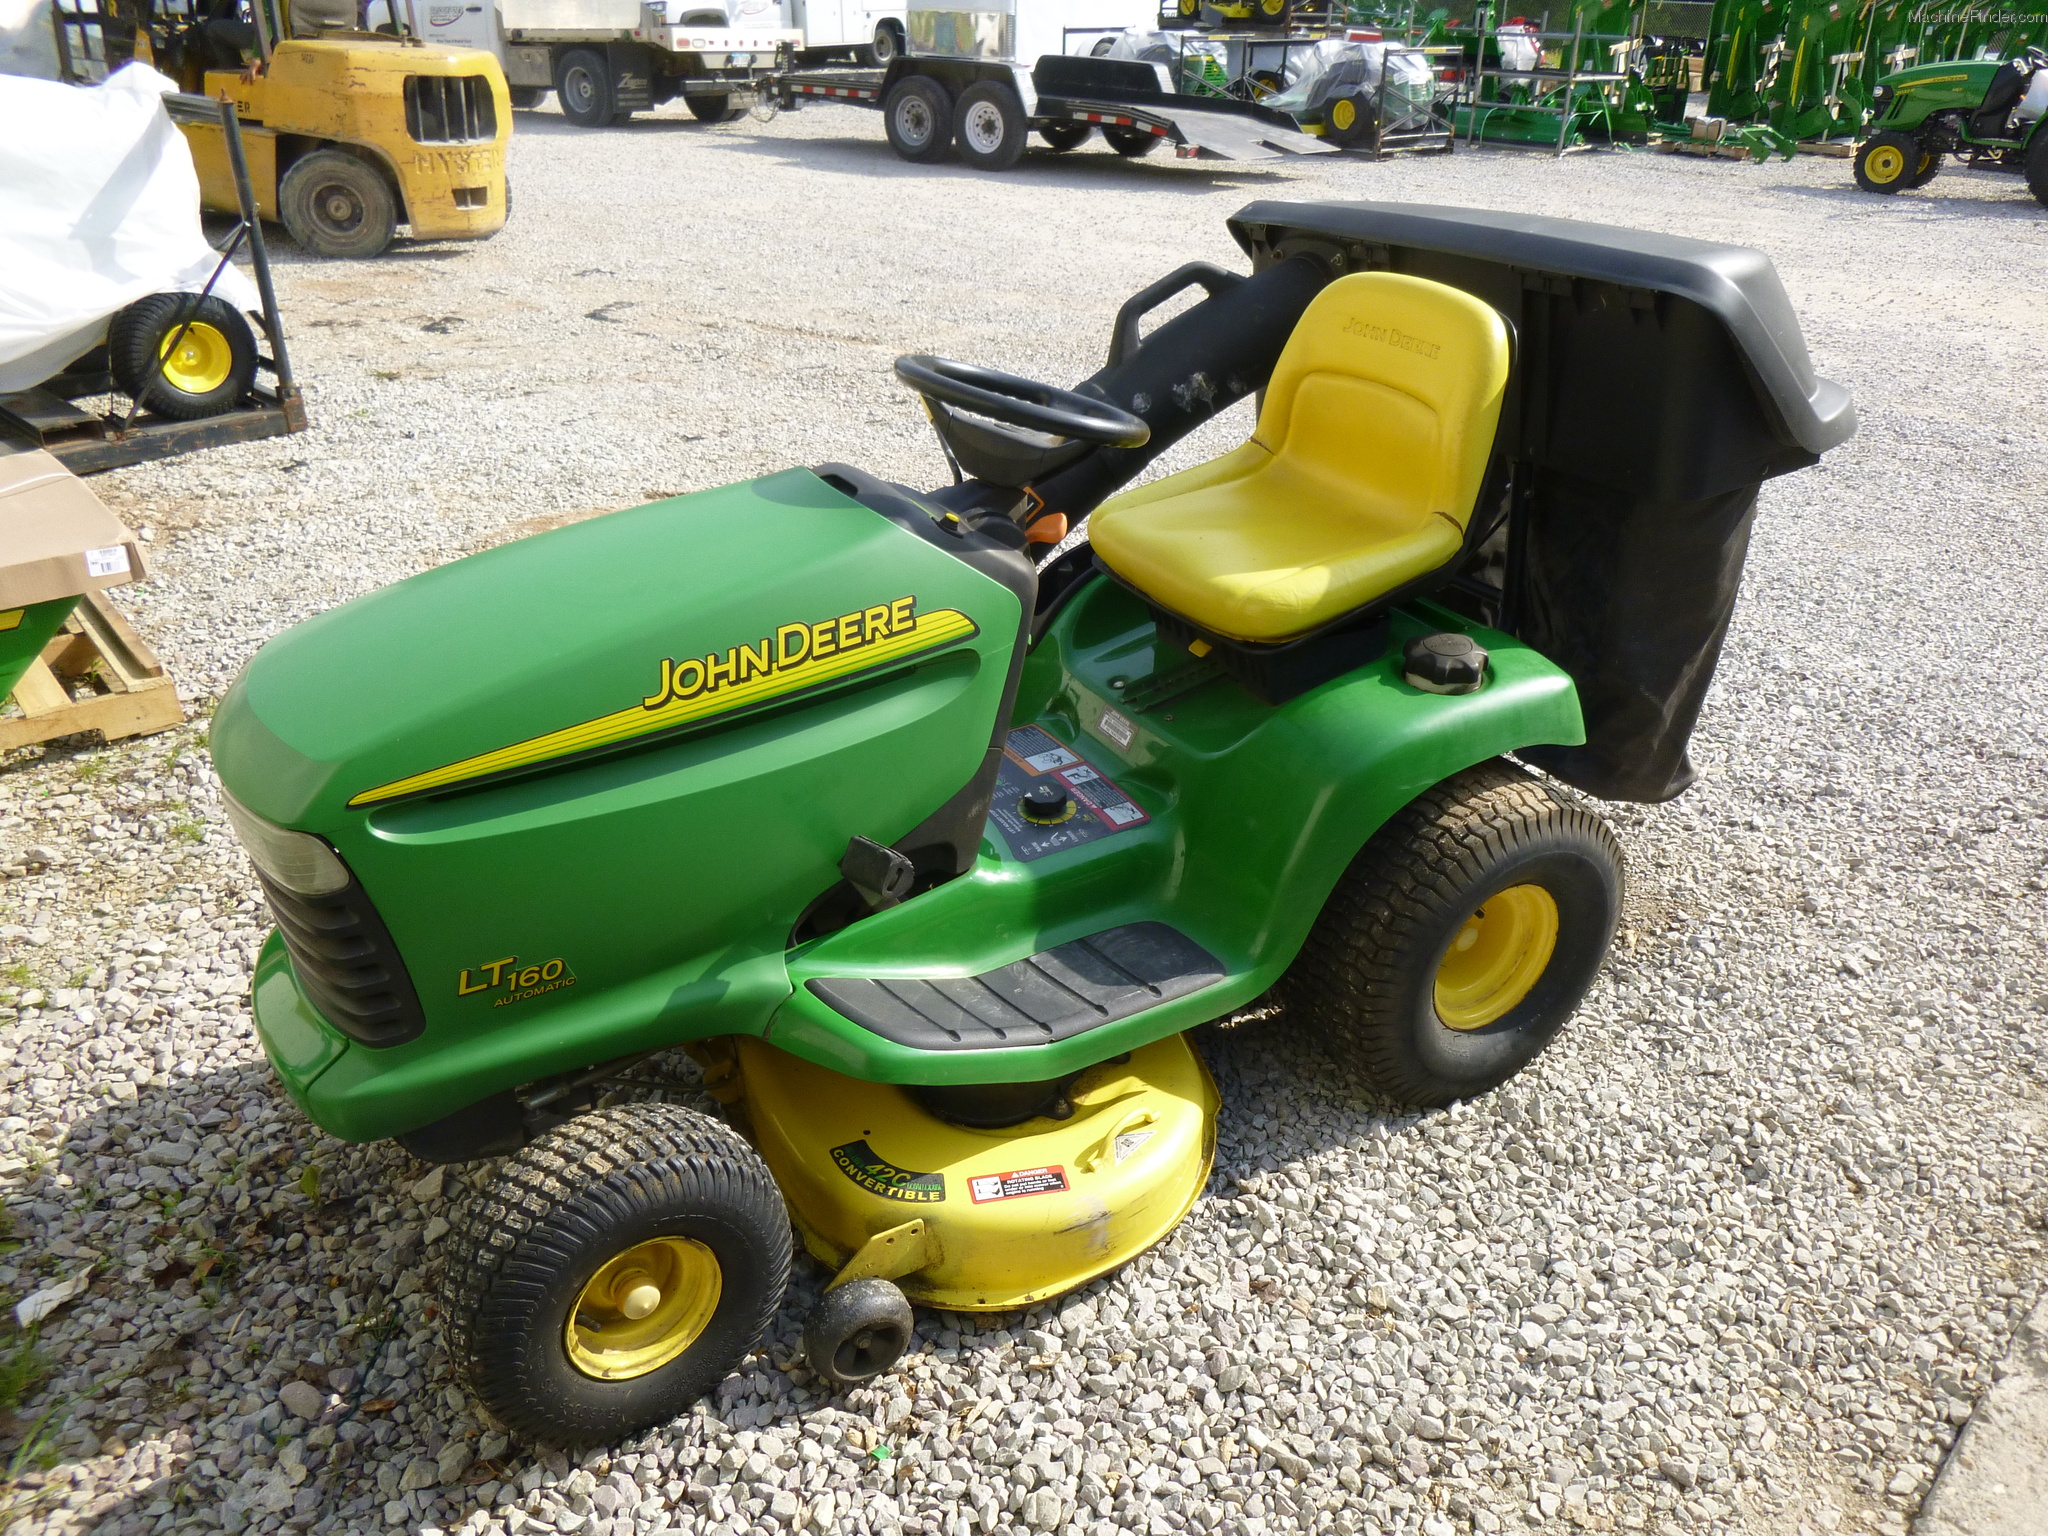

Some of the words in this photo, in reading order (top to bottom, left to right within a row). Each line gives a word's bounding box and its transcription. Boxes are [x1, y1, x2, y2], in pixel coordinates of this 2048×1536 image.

[1342, 317, 1387, 343] JOHN
[1388, 328, 1441, 360] DEERE
[643, 637, 774, 710] JOHN
[776, 594, 917, 672] DEERE
[493, 976, 577, 1009] AUTOMATIC
[833, 1149, 941, 1201] CONVERTIBLE
[865, 1164, 912, 1187] 42C
[1019, 1168, 1047, 1177] DANGER
